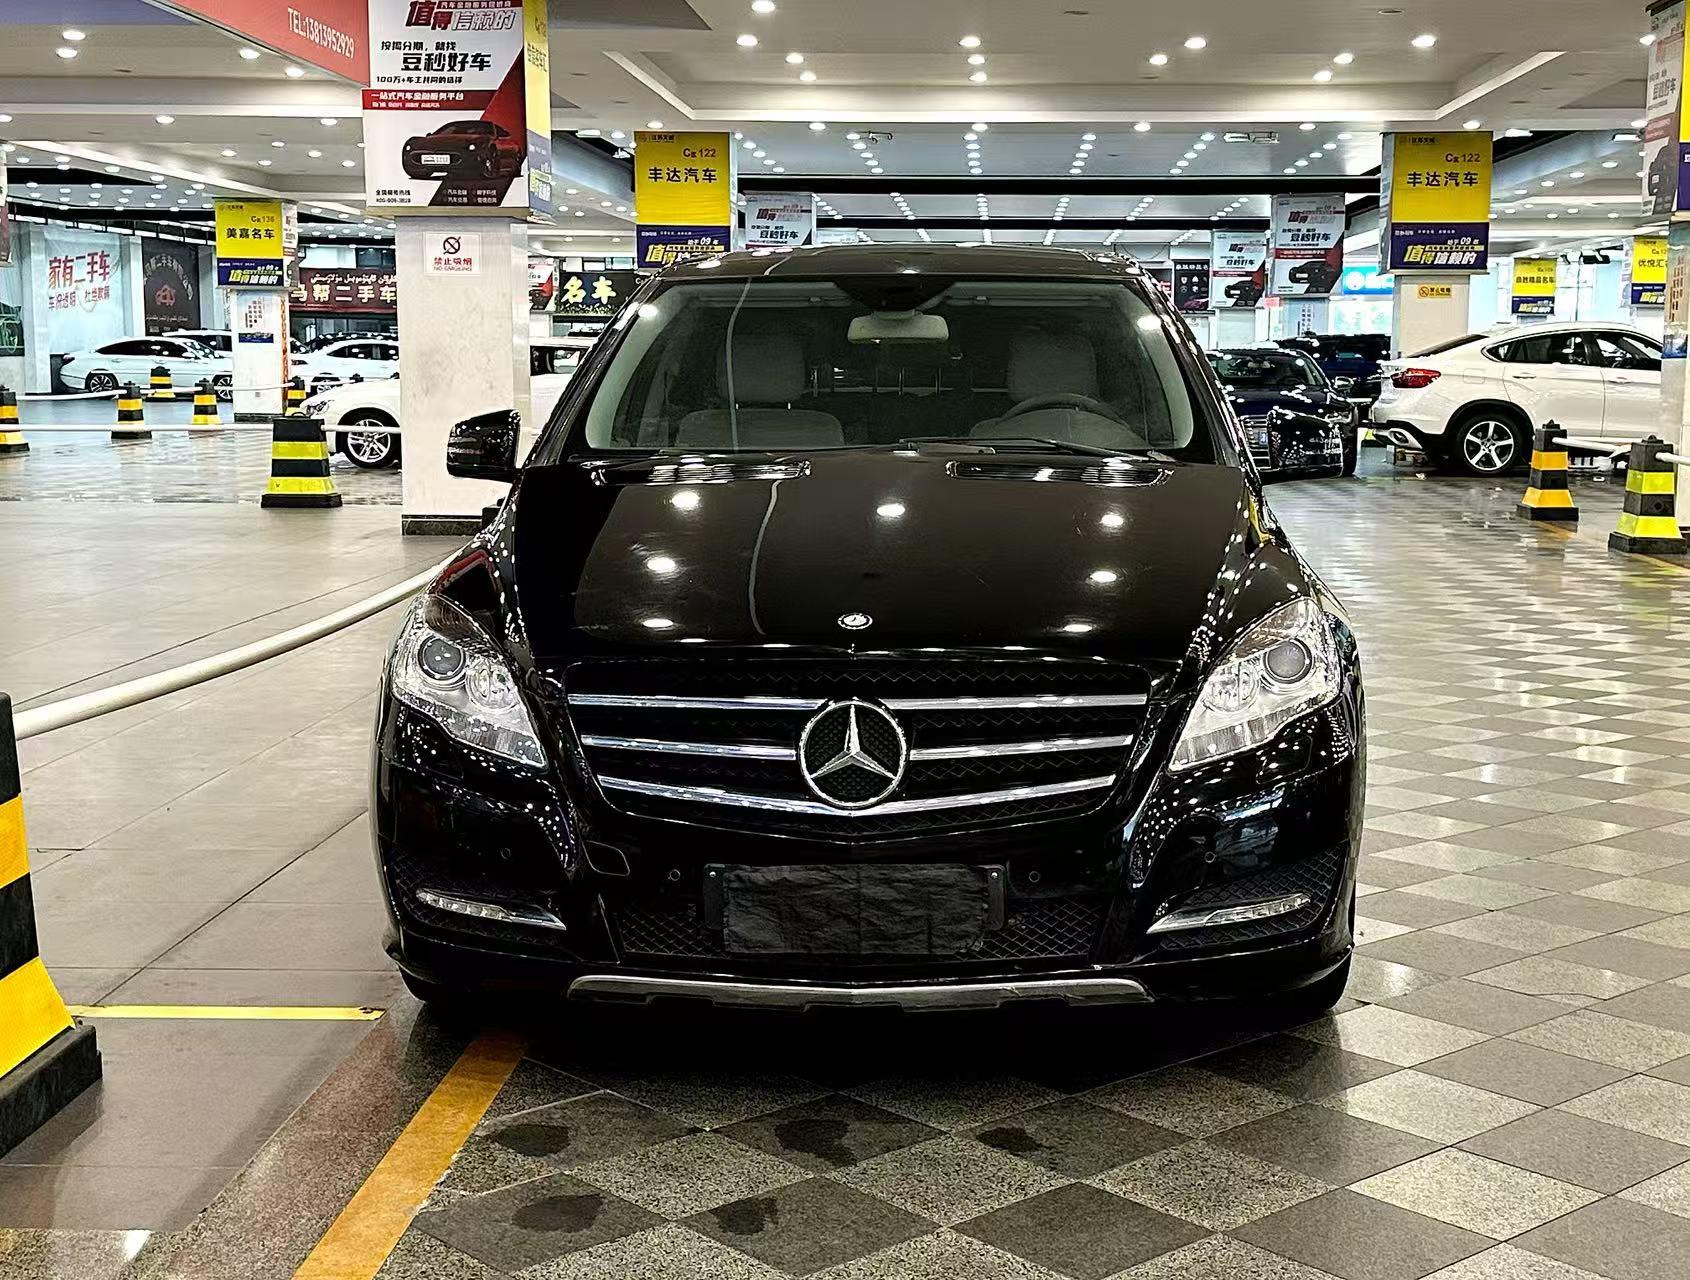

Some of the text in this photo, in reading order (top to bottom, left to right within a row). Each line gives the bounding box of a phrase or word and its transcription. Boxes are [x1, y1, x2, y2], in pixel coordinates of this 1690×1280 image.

[405, 0, 516, 31] 值得信赖的
[287, 6, 355, 59] TEL:13813952929
[401, 52, 492, 72] 豆秒好车
[699, 148, 716, 157] 122
[1461, 153, 1480, 162] 122
[648, 167, 717, 183] 丰达汽车
[1407, 171, 1479, 187] 丰达汽车
[226, 227, 275, 239] 美嘉名车
[433, 257, 472, 266] 禁止吸烟
[1404, 245, 1477, 265] 值得信赖的
[49, 250, 110, 289] 家有二手车
[560, 275, 617, 305] 名车
